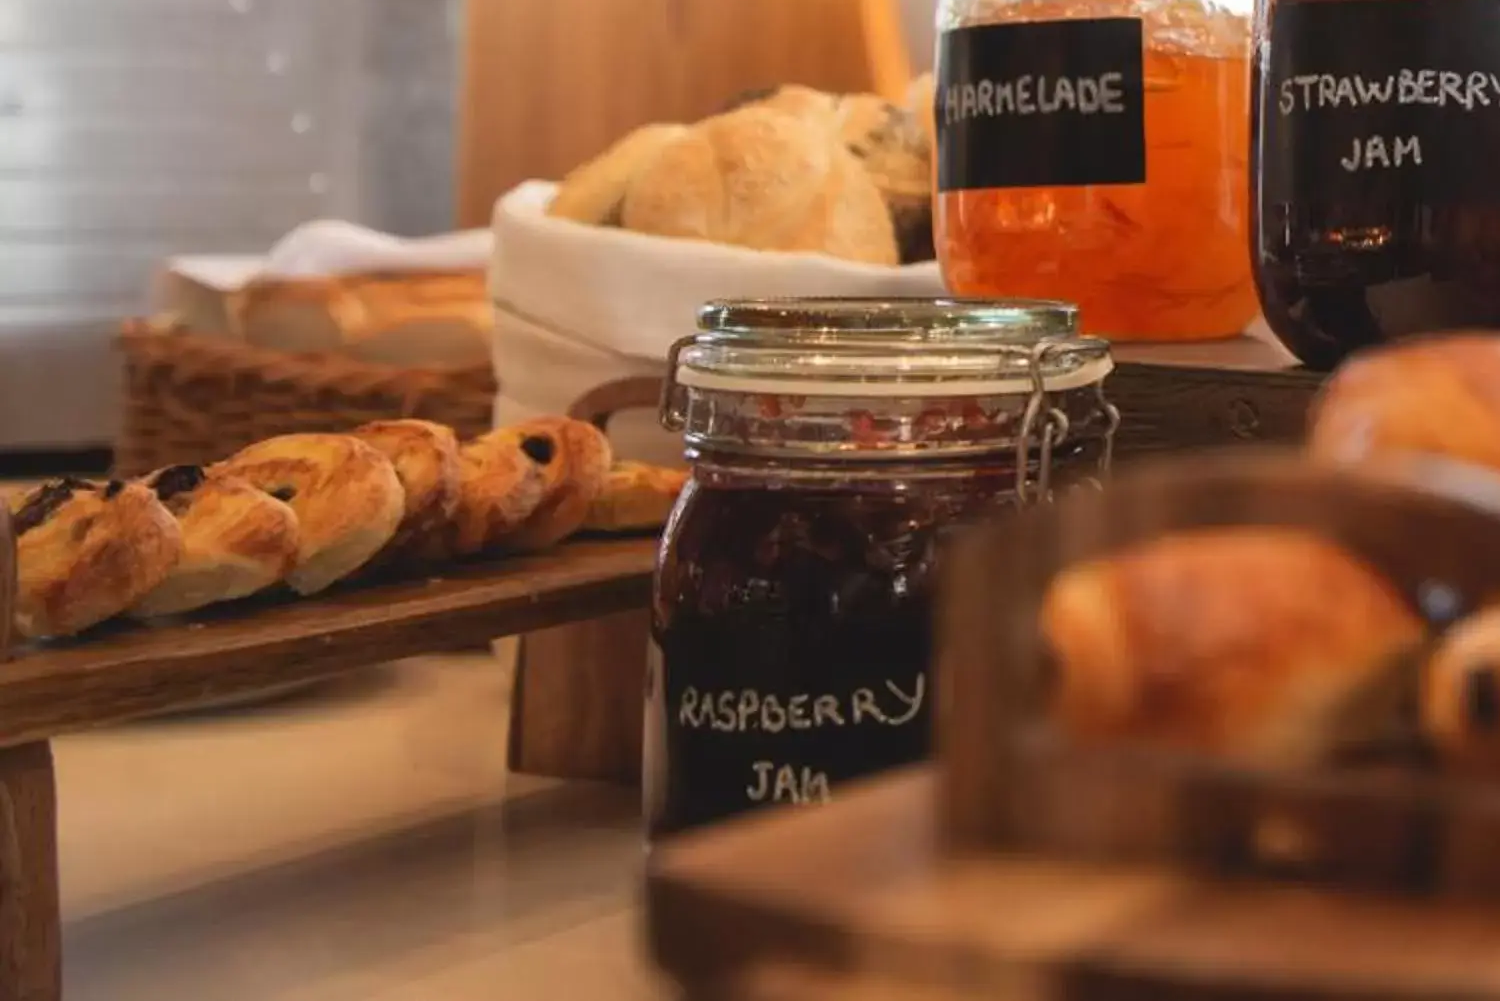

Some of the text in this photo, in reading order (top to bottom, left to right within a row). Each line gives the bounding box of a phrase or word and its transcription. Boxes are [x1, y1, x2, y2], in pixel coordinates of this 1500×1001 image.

[944, 71, 1126, 126] MARMELADE
[1340, 134, 1423, 172] JAM
[679, 671, 925, 734] RASPBERRY
[746, 759, 832, 805] JAM
